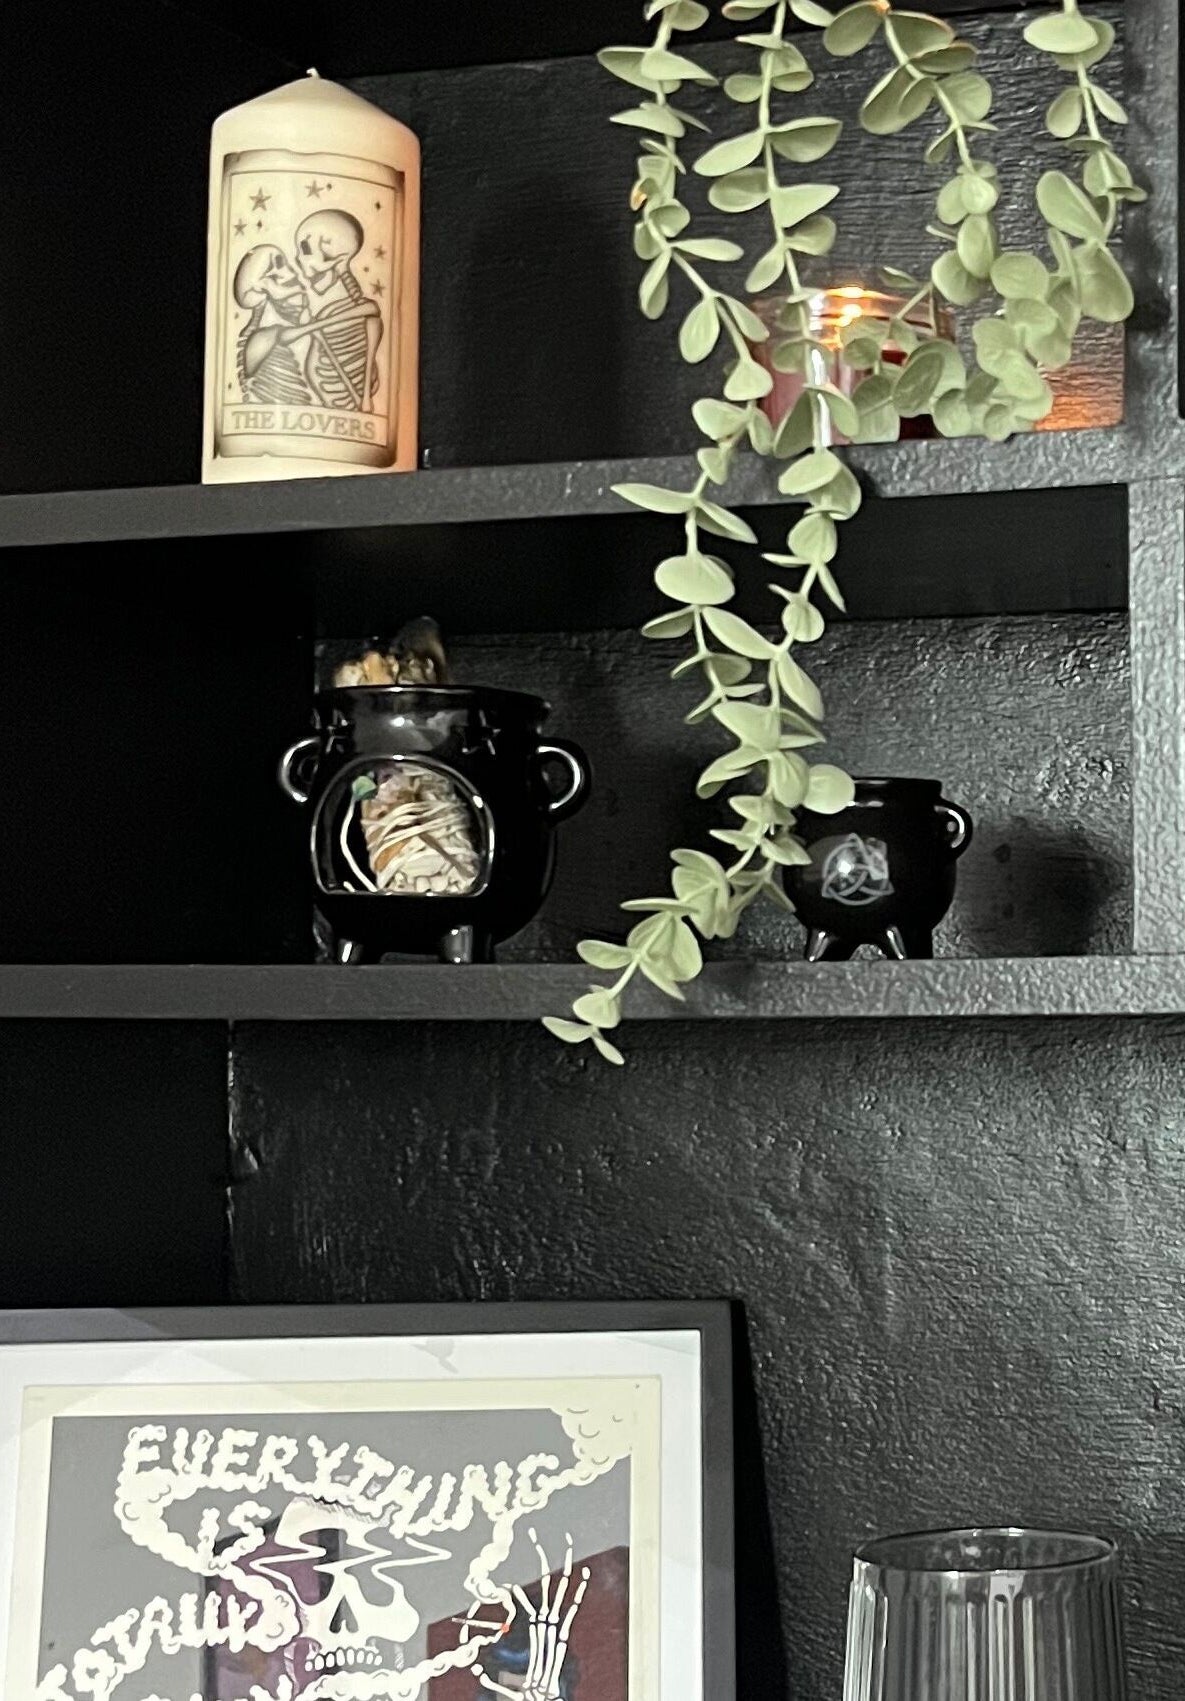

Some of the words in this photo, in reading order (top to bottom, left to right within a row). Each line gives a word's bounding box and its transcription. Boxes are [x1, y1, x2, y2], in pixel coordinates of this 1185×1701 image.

[231, 410, 274, 430] THE
[281, 411, 376, 440] LOVERS
[119, 1424, 560, 1537] EVERYTHING
[198, 1500, 272, 1568] IS
